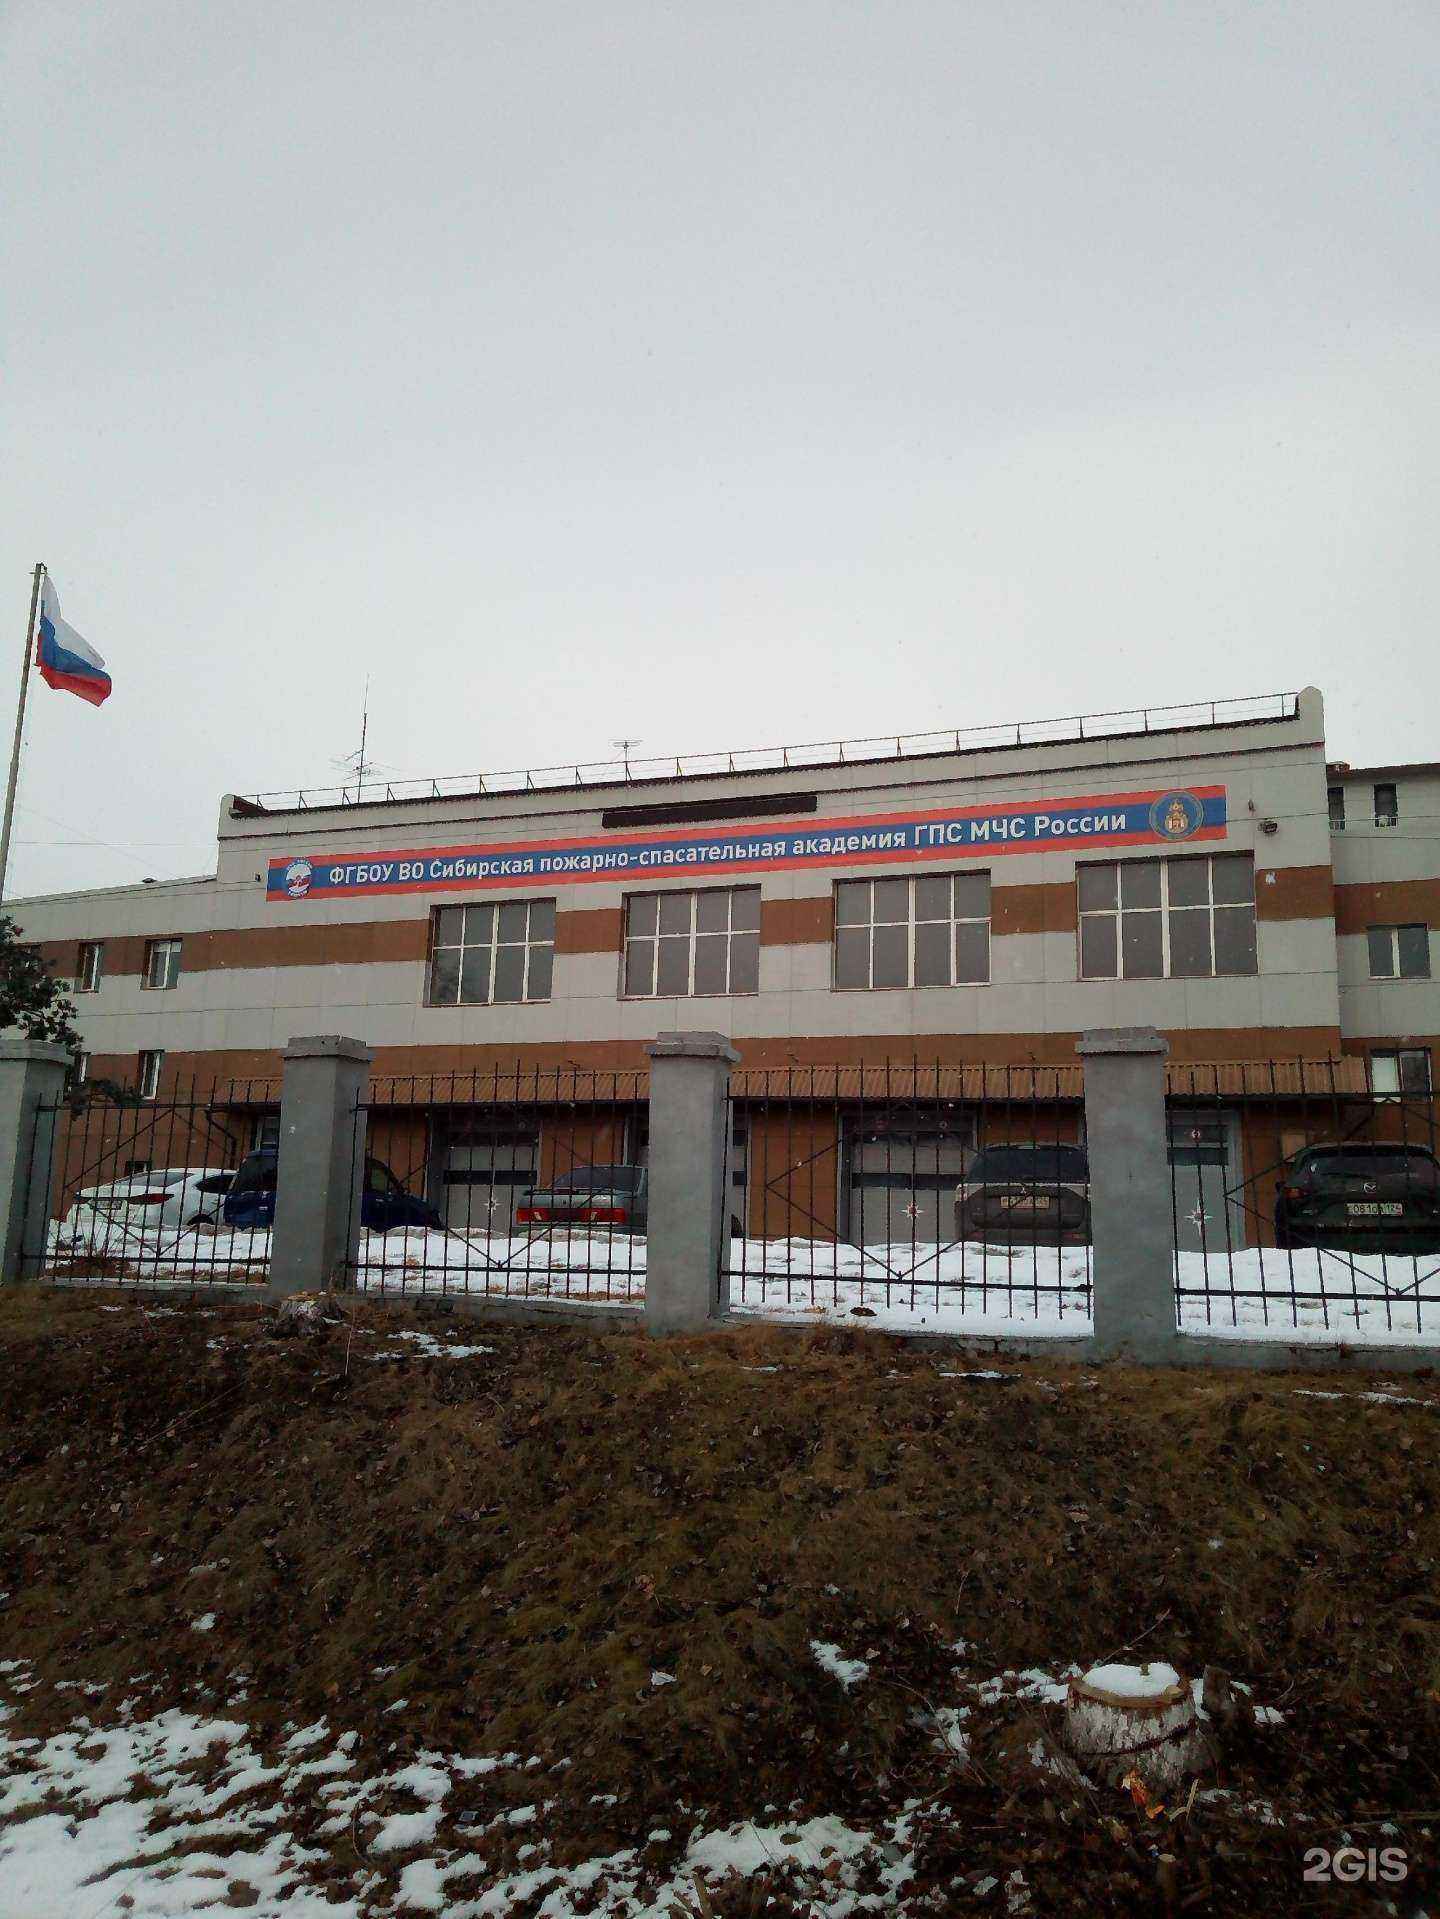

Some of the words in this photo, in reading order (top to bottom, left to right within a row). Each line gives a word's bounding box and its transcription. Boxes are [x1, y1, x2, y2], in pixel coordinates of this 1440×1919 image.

[330, 864, 394, 884] ФГБОУ
[398, 861, 425, 881] ВО
[430, 858, 534, 879] Сибирская
[540, 840, 786, 872] пожарно-спасательная
[793, 832, 906, 855] академия
[914, 823, 963, 846] ГПС
[971, 818, 1026, 841] МЧС
[1035, 814, 1126, 837] России
